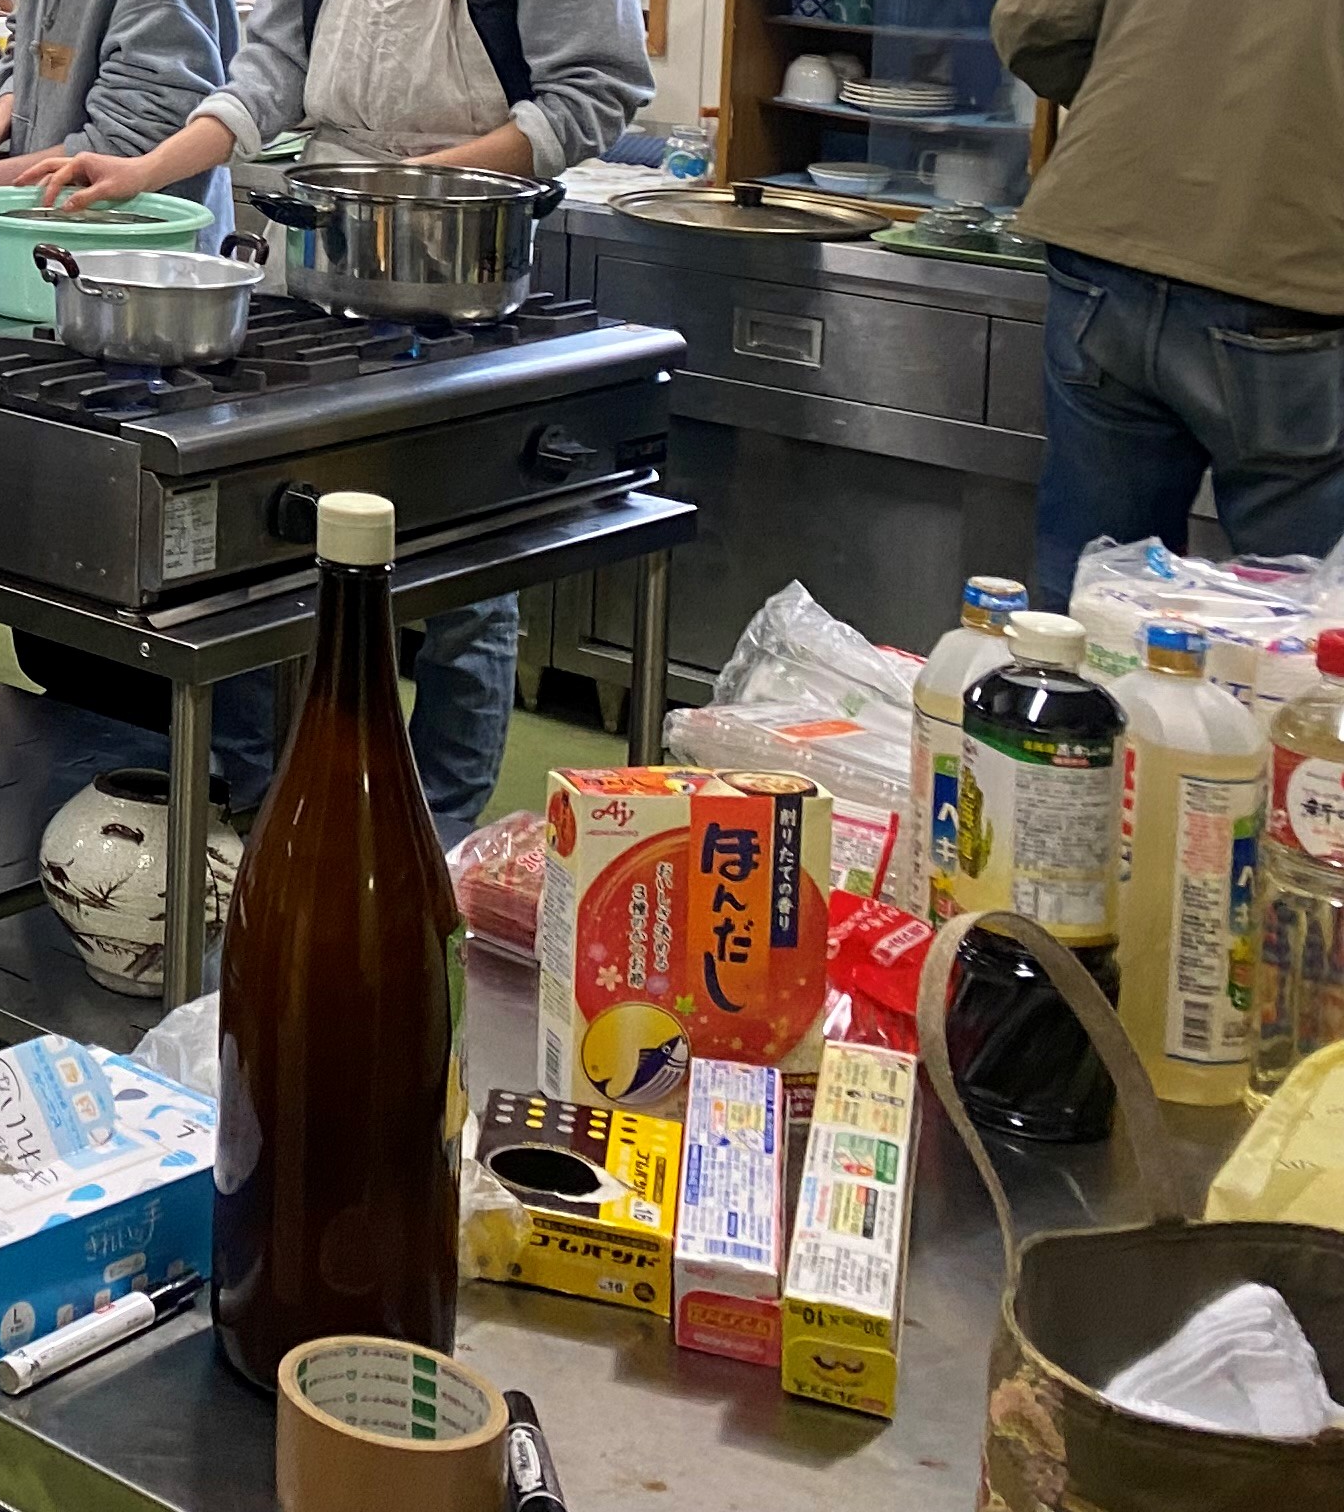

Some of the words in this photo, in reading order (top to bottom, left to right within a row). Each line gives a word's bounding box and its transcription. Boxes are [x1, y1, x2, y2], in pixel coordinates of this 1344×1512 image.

[701, 823, 761, 1013] ほんだし
[776, 807, 799, 932] 削りたての香り
